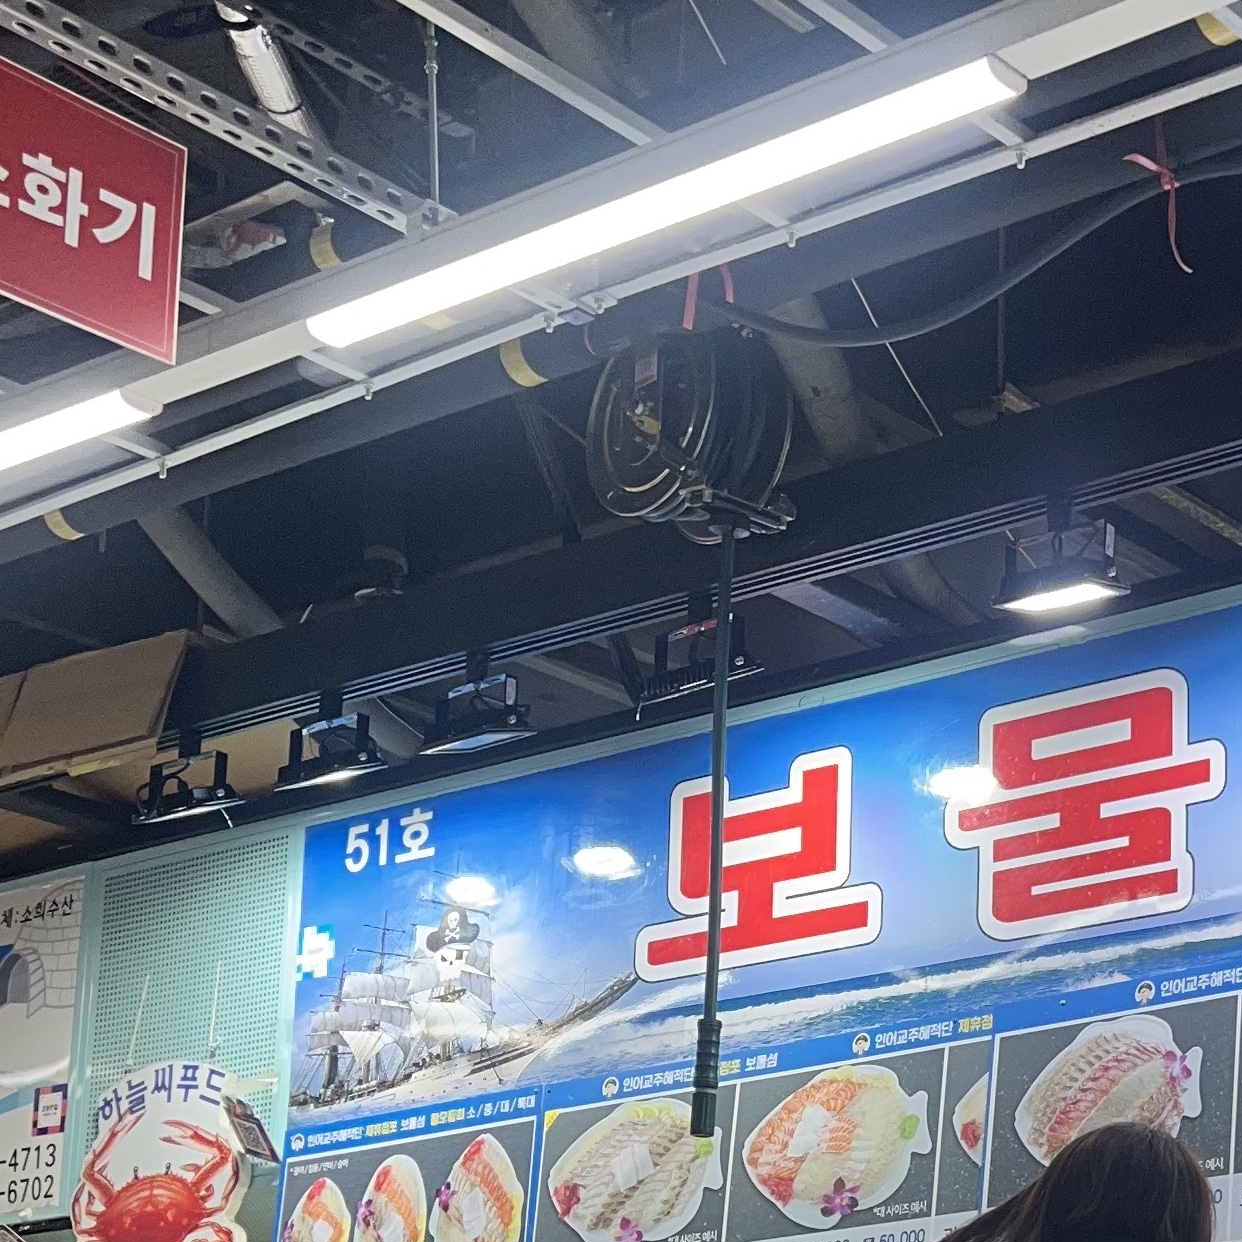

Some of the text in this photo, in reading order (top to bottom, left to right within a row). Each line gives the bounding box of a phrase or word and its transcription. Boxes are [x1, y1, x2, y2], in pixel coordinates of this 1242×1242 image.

[0, 152, 156, 282] 화기
[344, 807, 436, 873] 51호
[874, 1020, 954, 1050] 인어교주해적단
[99, 1064, 228, 1122] 하늘씨푸드
[622, 1071, 695, 1092] 인어교주해적단
[1205, 1157, 1225, 1171] 예시
[885, 1204, 910, 1218] 사이즈
[910, 1200, 928, 1213] 예시
[702, 1229, 718, 1242] 예시
